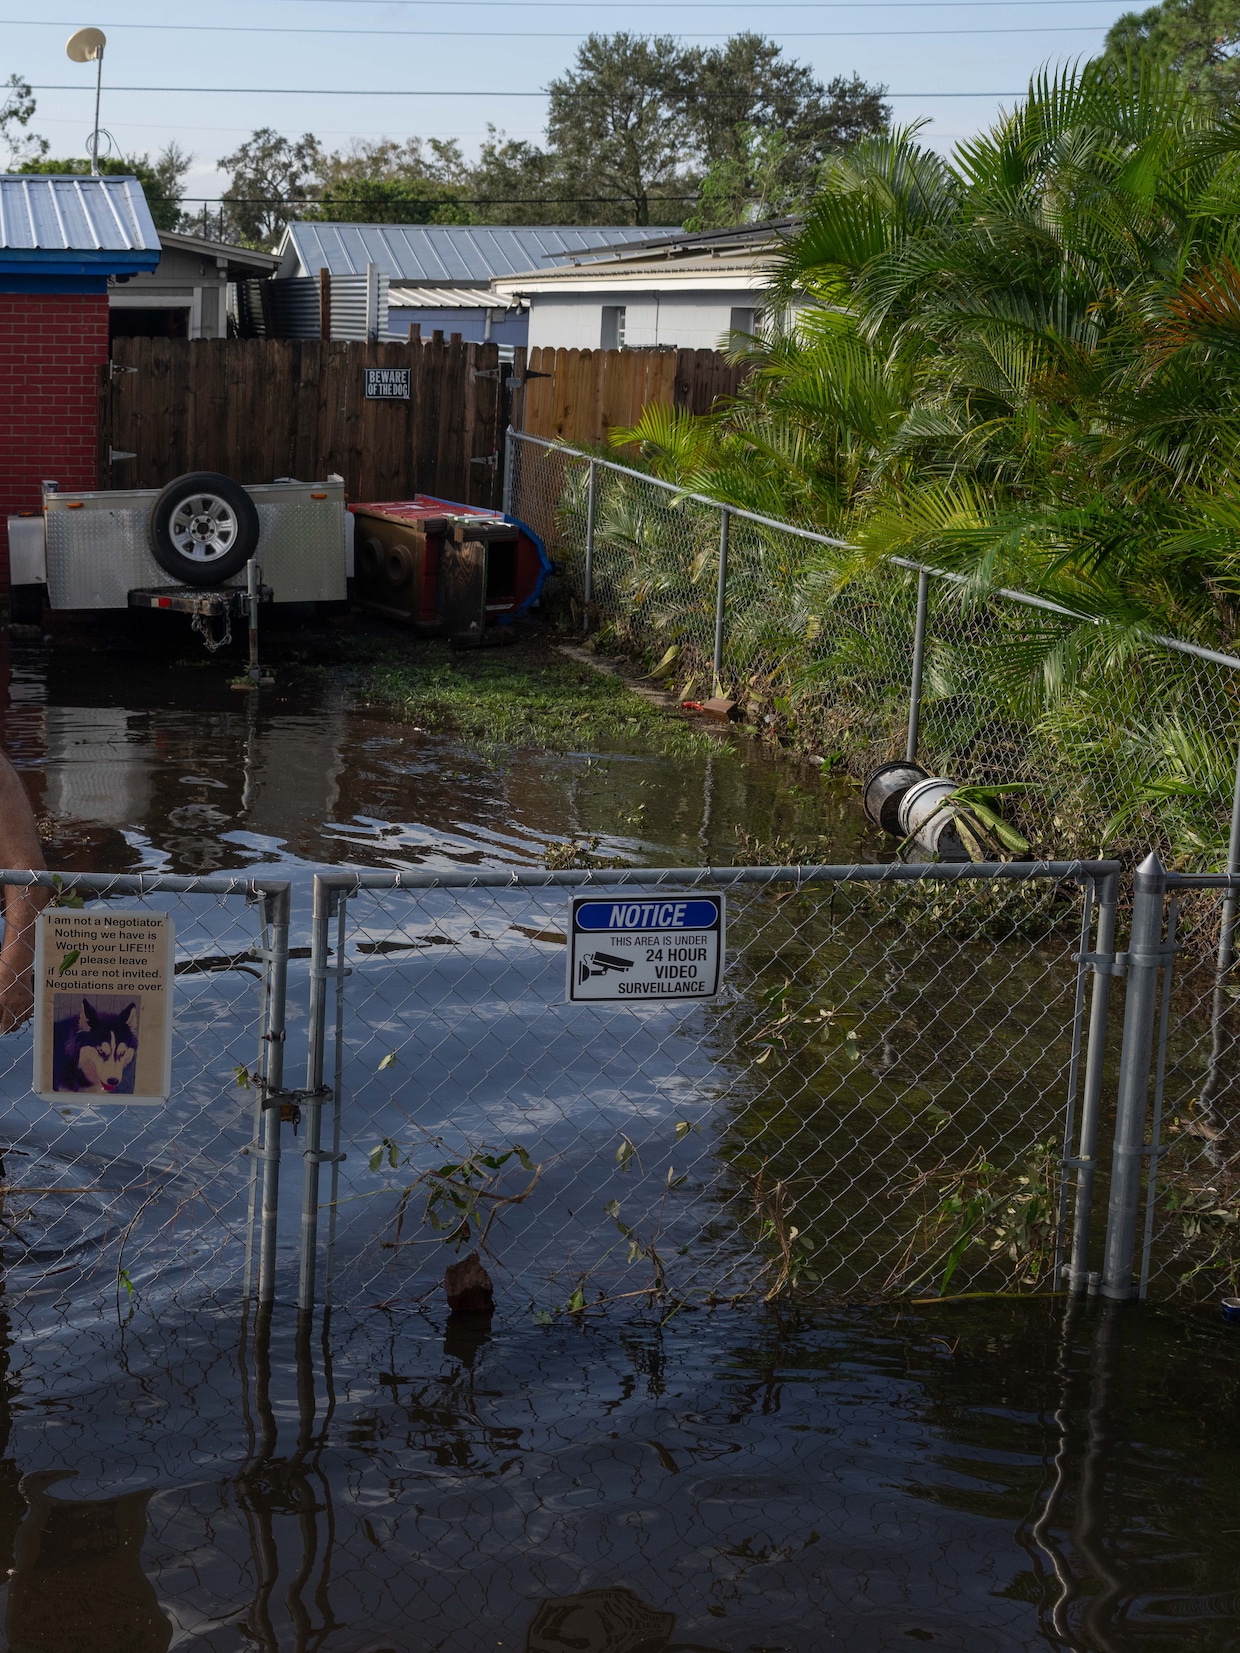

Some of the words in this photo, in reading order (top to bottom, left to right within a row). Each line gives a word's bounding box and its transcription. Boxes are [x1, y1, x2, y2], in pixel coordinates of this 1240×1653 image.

[369, 371, 407, 383] BEWARE
[368, 384, 377, 395] OF
[379, 384, 392, 395] THE
[393, 384, 407, 395] DOG
[48, 915, 51, 924] I
[54, 917, 71, 925] am
[74, 917, 91, 926] not
[94, 918, 101, 926] a
[104, 917, 164, 928] Negotiator.
[609, 904, 687, 928] NOTICE
[55, 928, 97, 940] Nothing
[100, 931, 116, 939] we
[119, 930, 145, 940] have
[148, 931, 157, 940] is
[610, 936, 632, 946] THIS
[634, 936, 660, 946] AREA
[663, 935, 672, 946] IS
[675, 935, 707, 945] UNDER
[56, 941, 89, 951] Worth
[92, 944, 116, 953] your
[119, 943, 155, 953] LIFE!!!
[80, 956, 116, 965] please
[119, 956, 148, 965] leave
[646, 949, 663, 962] 24
[668, 948, 707, 961] HOUR
[48, 967, 55, 976] if
[59, 969, 78, 977] you
[81, 969, 99, 977] are
[102, 969, 120, 978] not
[122, 969, 162, 978] invited.
[655, 965, 697, 979] VIDEO
[45, 979, 114, 991] Negotiations
[117, 982, 135, 990] are
[137, 982, 163, 991] over.
[618, 981, 706, 994] SURVEILLANCE
